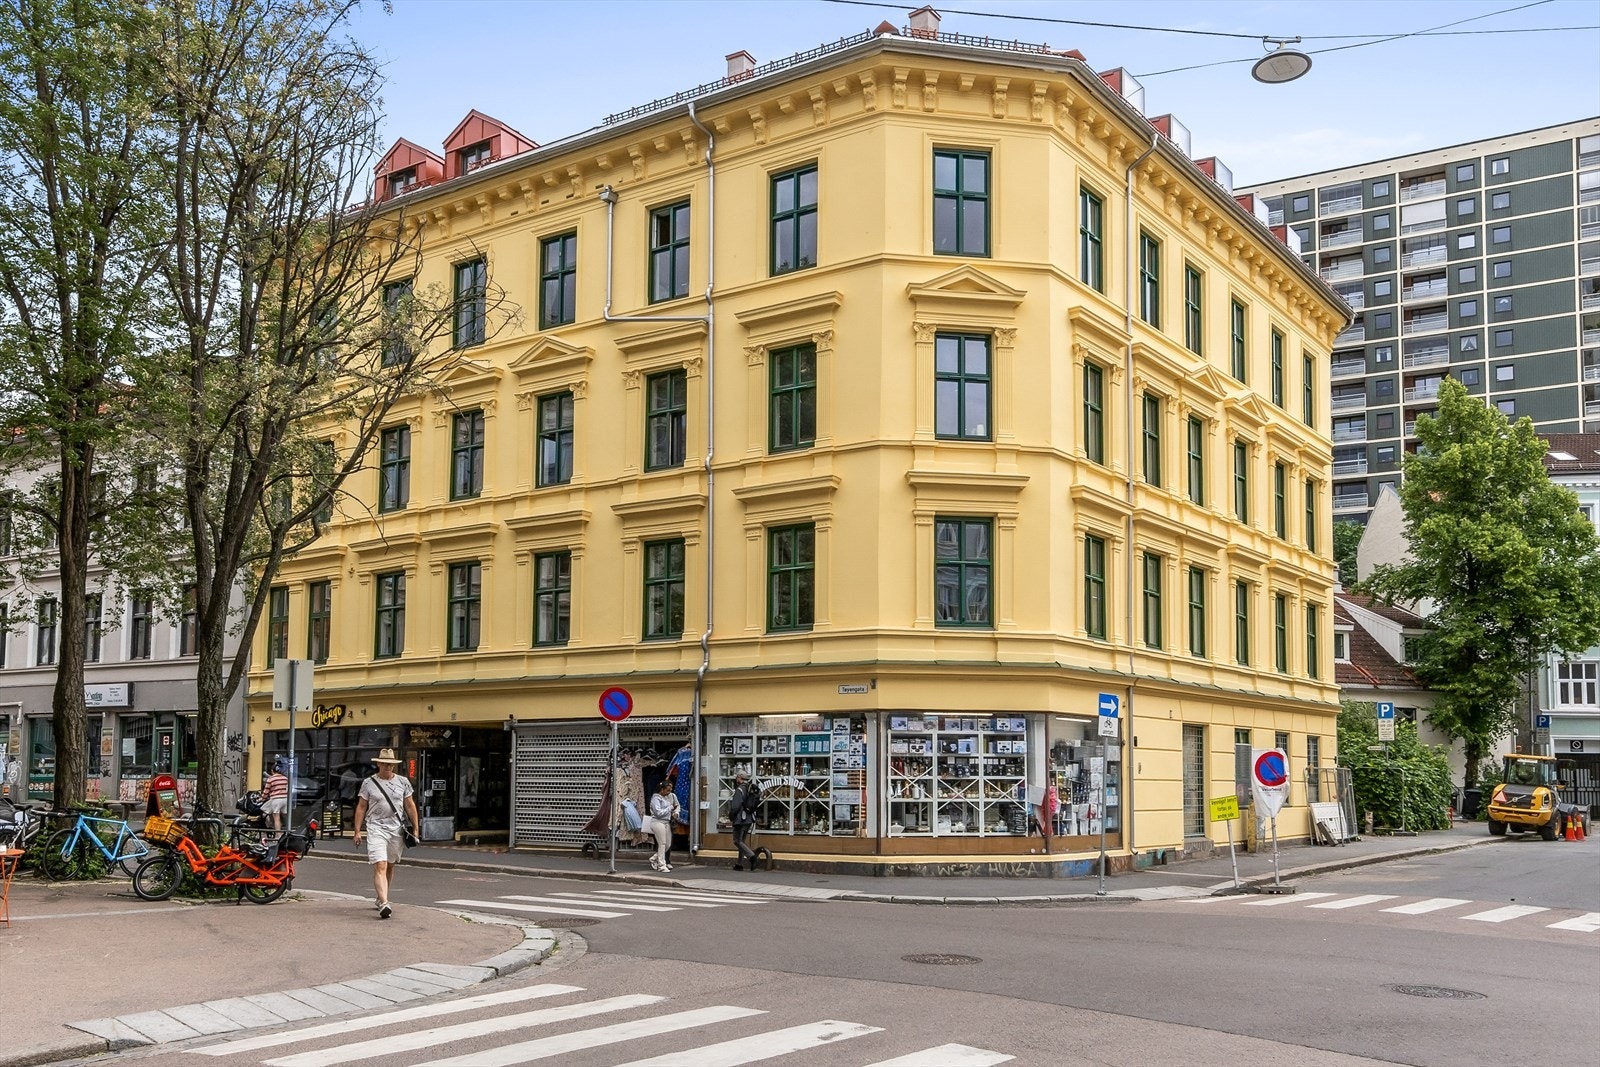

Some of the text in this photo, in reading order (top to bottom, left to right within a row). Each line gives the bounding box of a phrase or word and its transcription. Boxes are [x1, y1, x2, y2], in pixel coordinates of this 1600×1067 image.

[312, 705, 342, 727] Chicago
[1381, 704, 1390, 717] P
[1539, 716, 1547, 727] P
[783, 775, 804, 790] Shop
